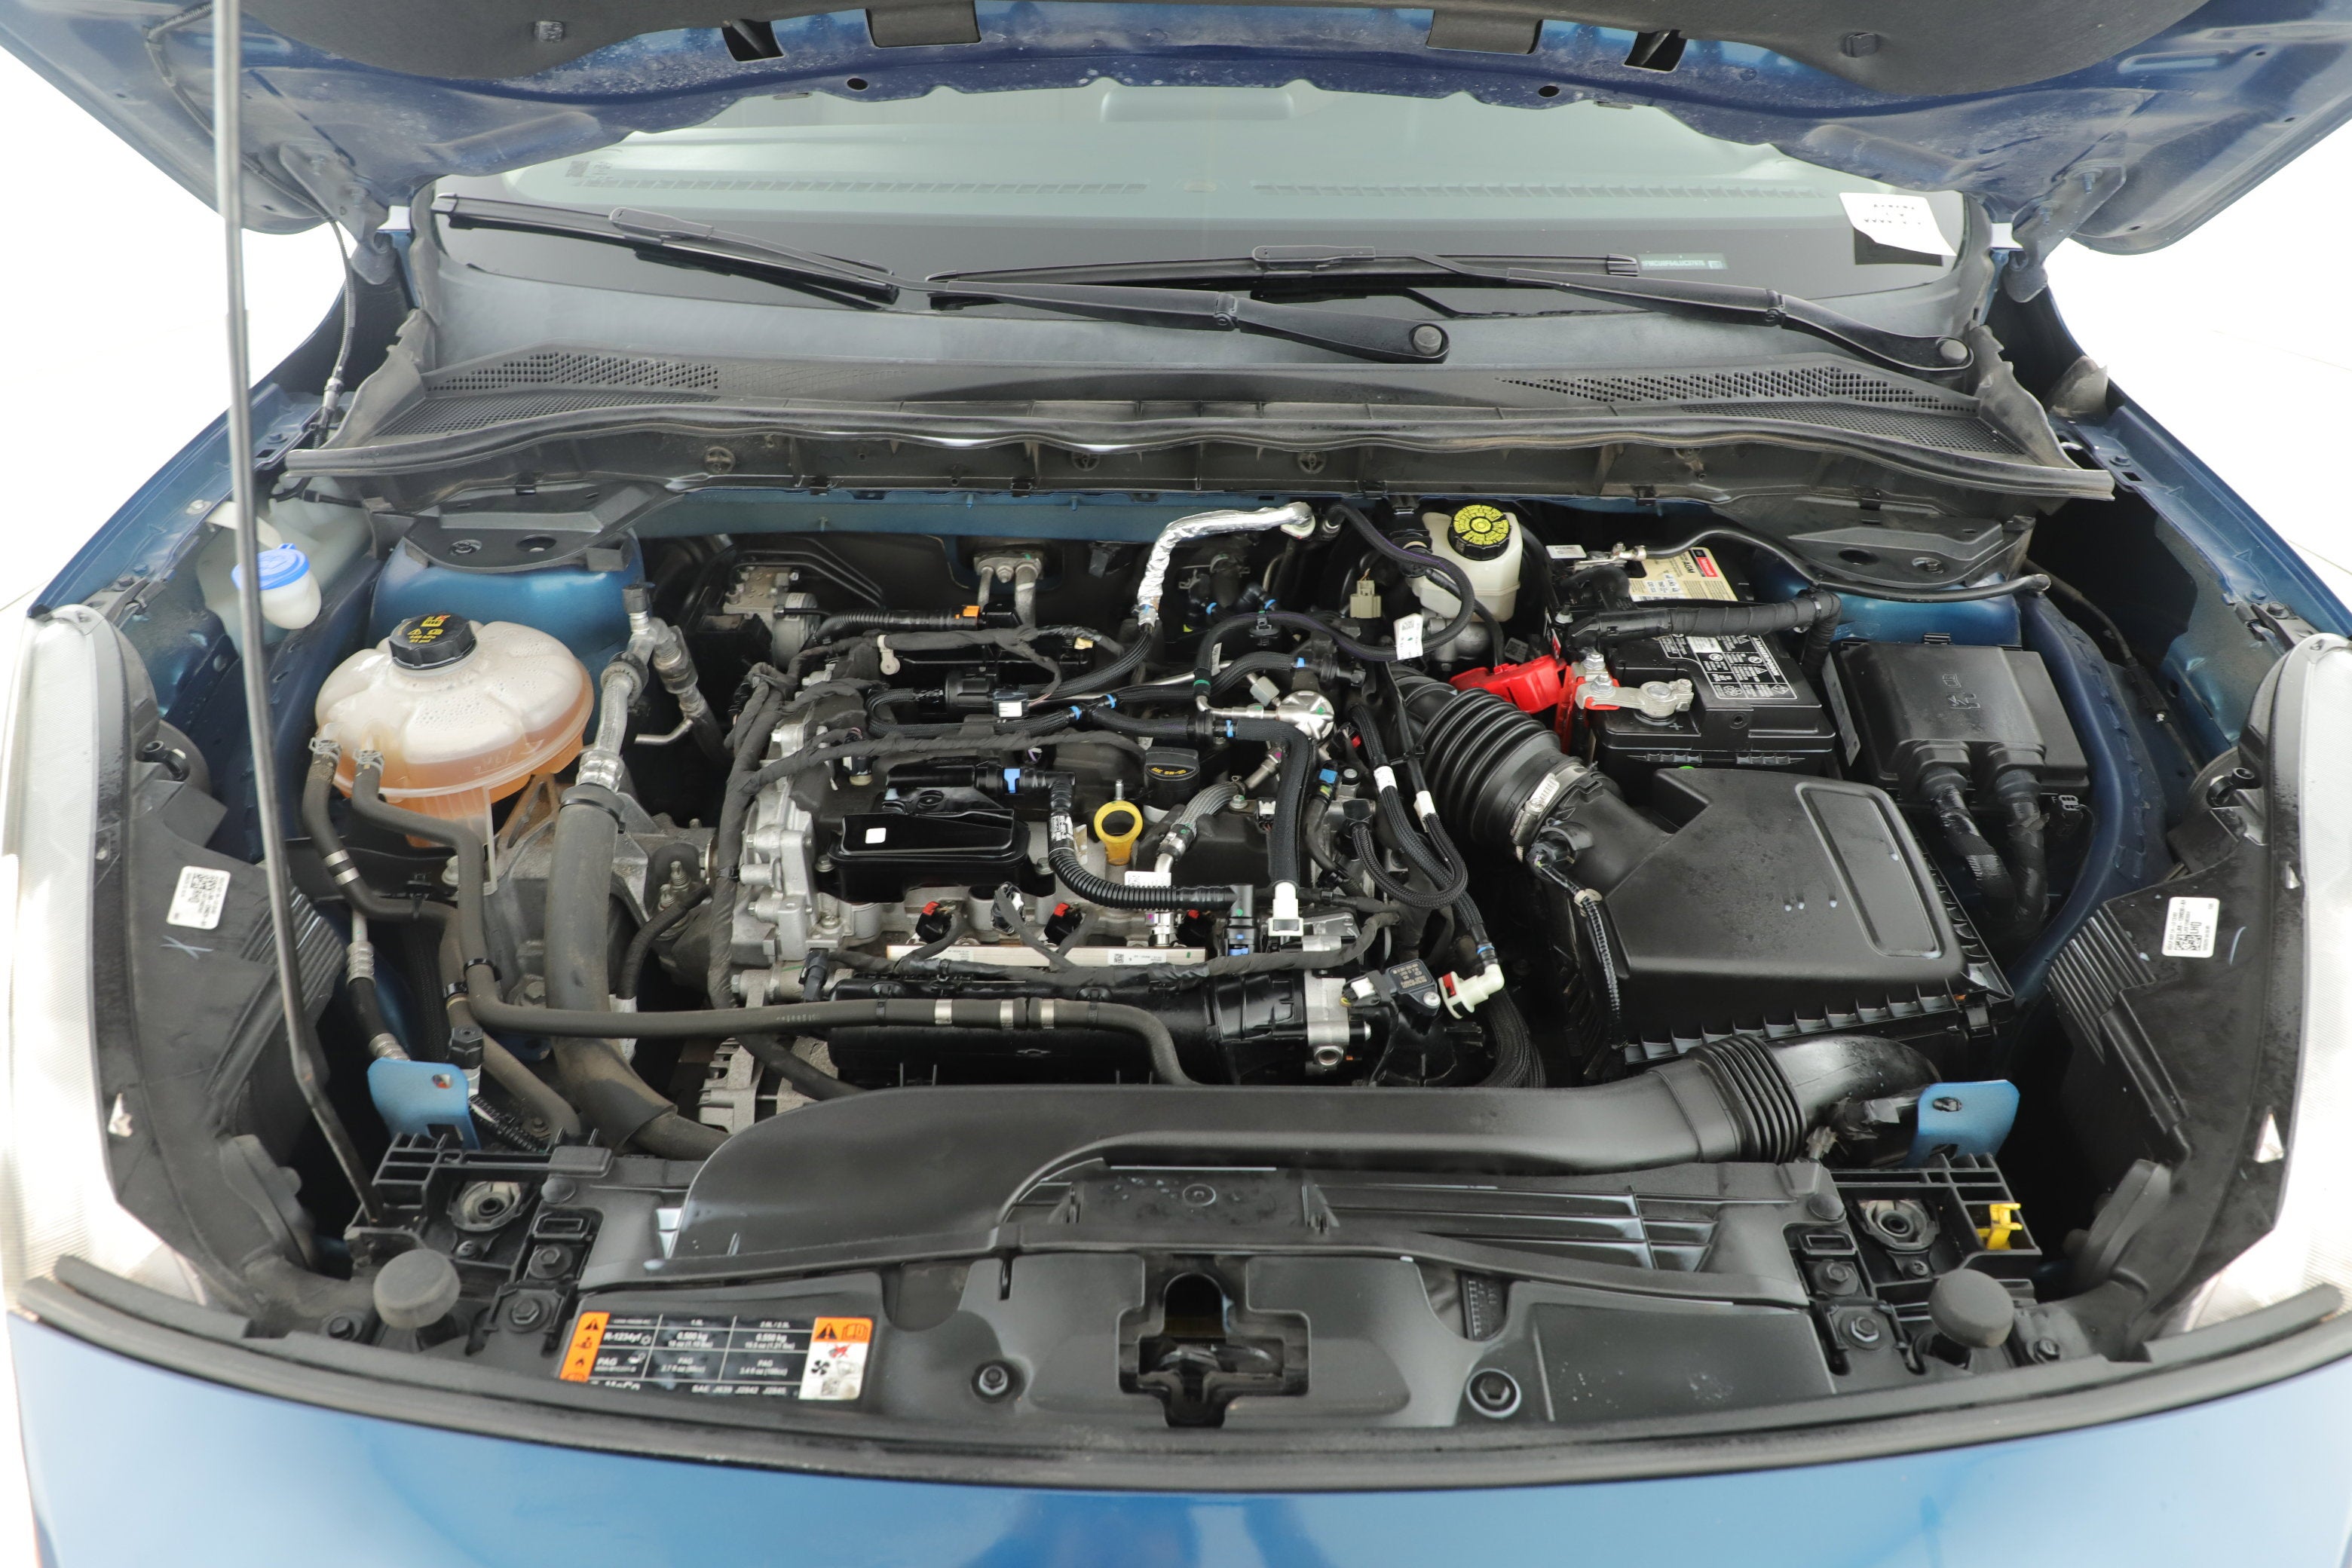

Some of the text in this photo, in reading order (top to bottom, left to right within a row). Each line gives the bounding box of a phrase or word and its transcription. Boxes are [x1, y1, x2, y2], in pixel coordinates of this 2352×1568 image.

[1683, 561, 1695, 574] AGM
[603, 1331, 642, 1343] R-1234yf
[596, 1357, 618, 1366] PAG
[757, 1359, 773, 1367] PAG
[691, 1384, 710, 1393] SAE
